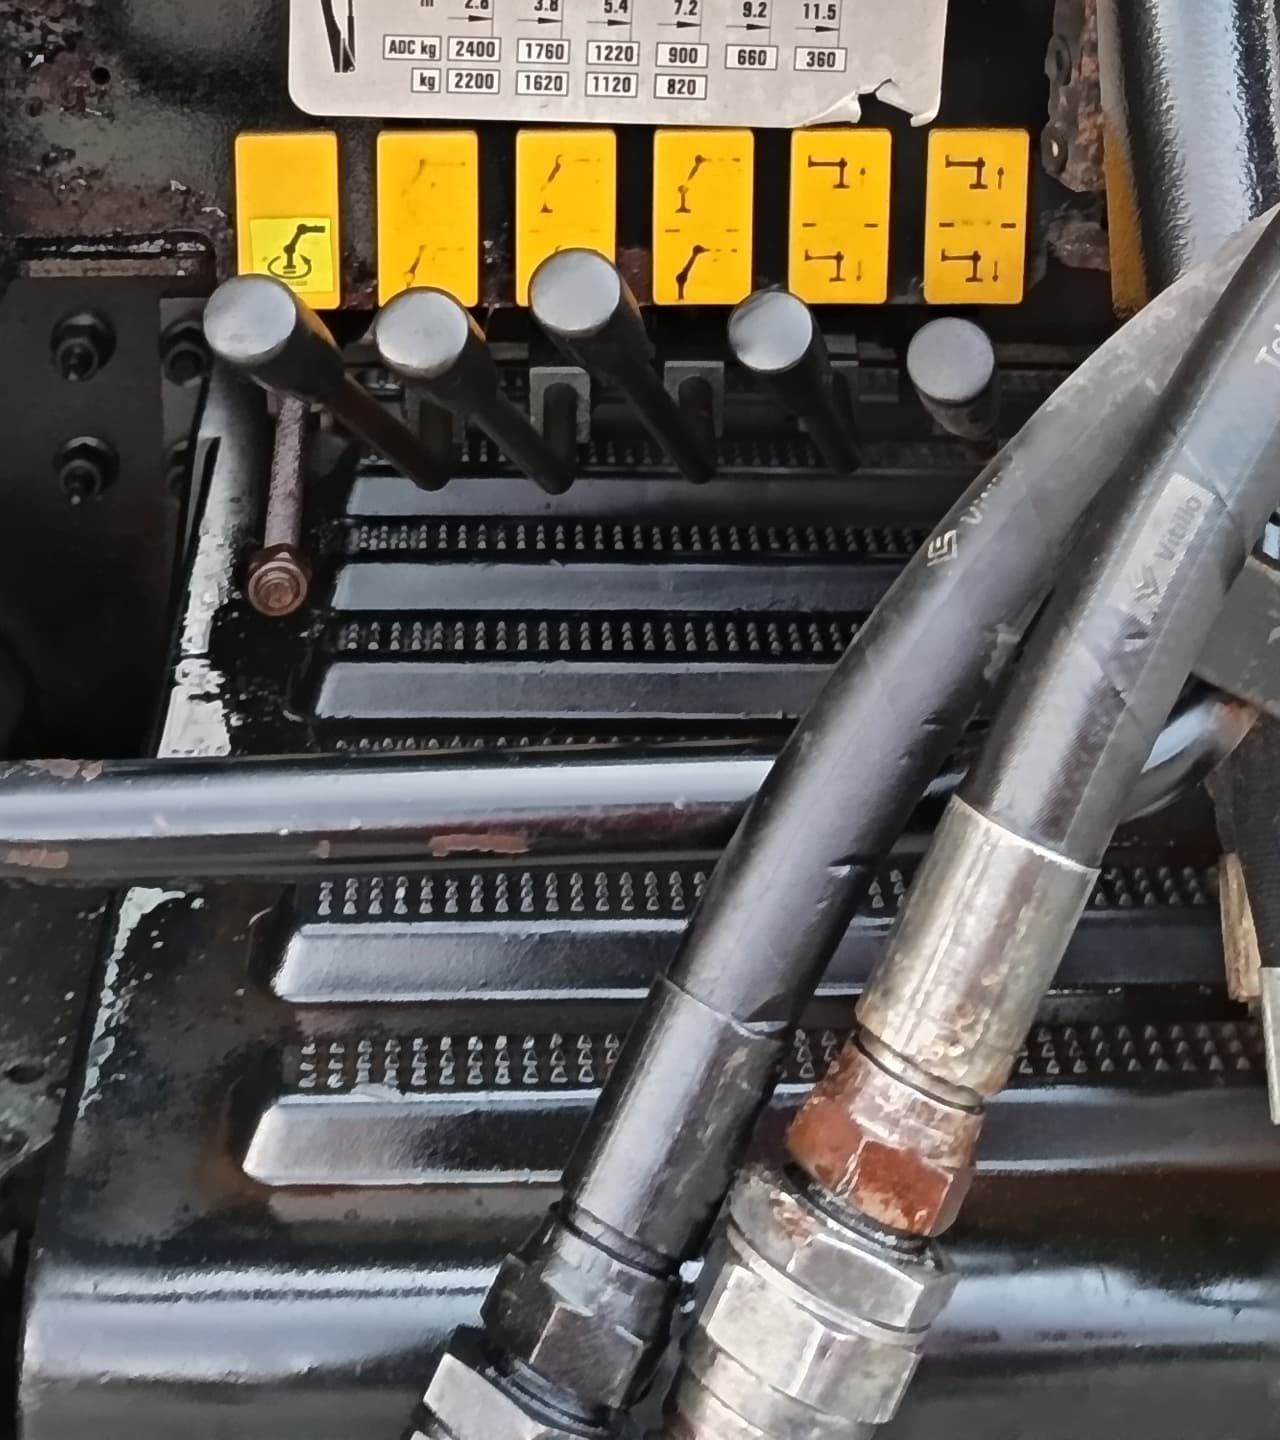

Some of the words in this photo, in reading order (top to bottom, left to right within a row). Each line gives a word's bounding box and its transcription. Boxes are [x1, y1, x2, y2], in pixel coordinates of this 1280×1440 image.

[674, 0, 698, 16] 7.2
[742, 1, 767, 18] 9.2
[803, 3, 837, 20] 11.5
[389, 39, 416, 55] ADC
[420, 40, 437, 58] kg
[455, 40, 495, 57] 2400
[525, 43, 564, 60] 1760
[595, 45, 634, 62] 1220
[668, 47, 698, 64] 900
[737, 49, 767, 66] 660
[806, 51, 836, 68] 360
[419, 73, 436, 91] kg
[454, 73, 494, 89] 2200
[524, 74, 563, 92] 1620
[592, 76, 631, 93] 1120
[667, 78, 697, 96] 820
